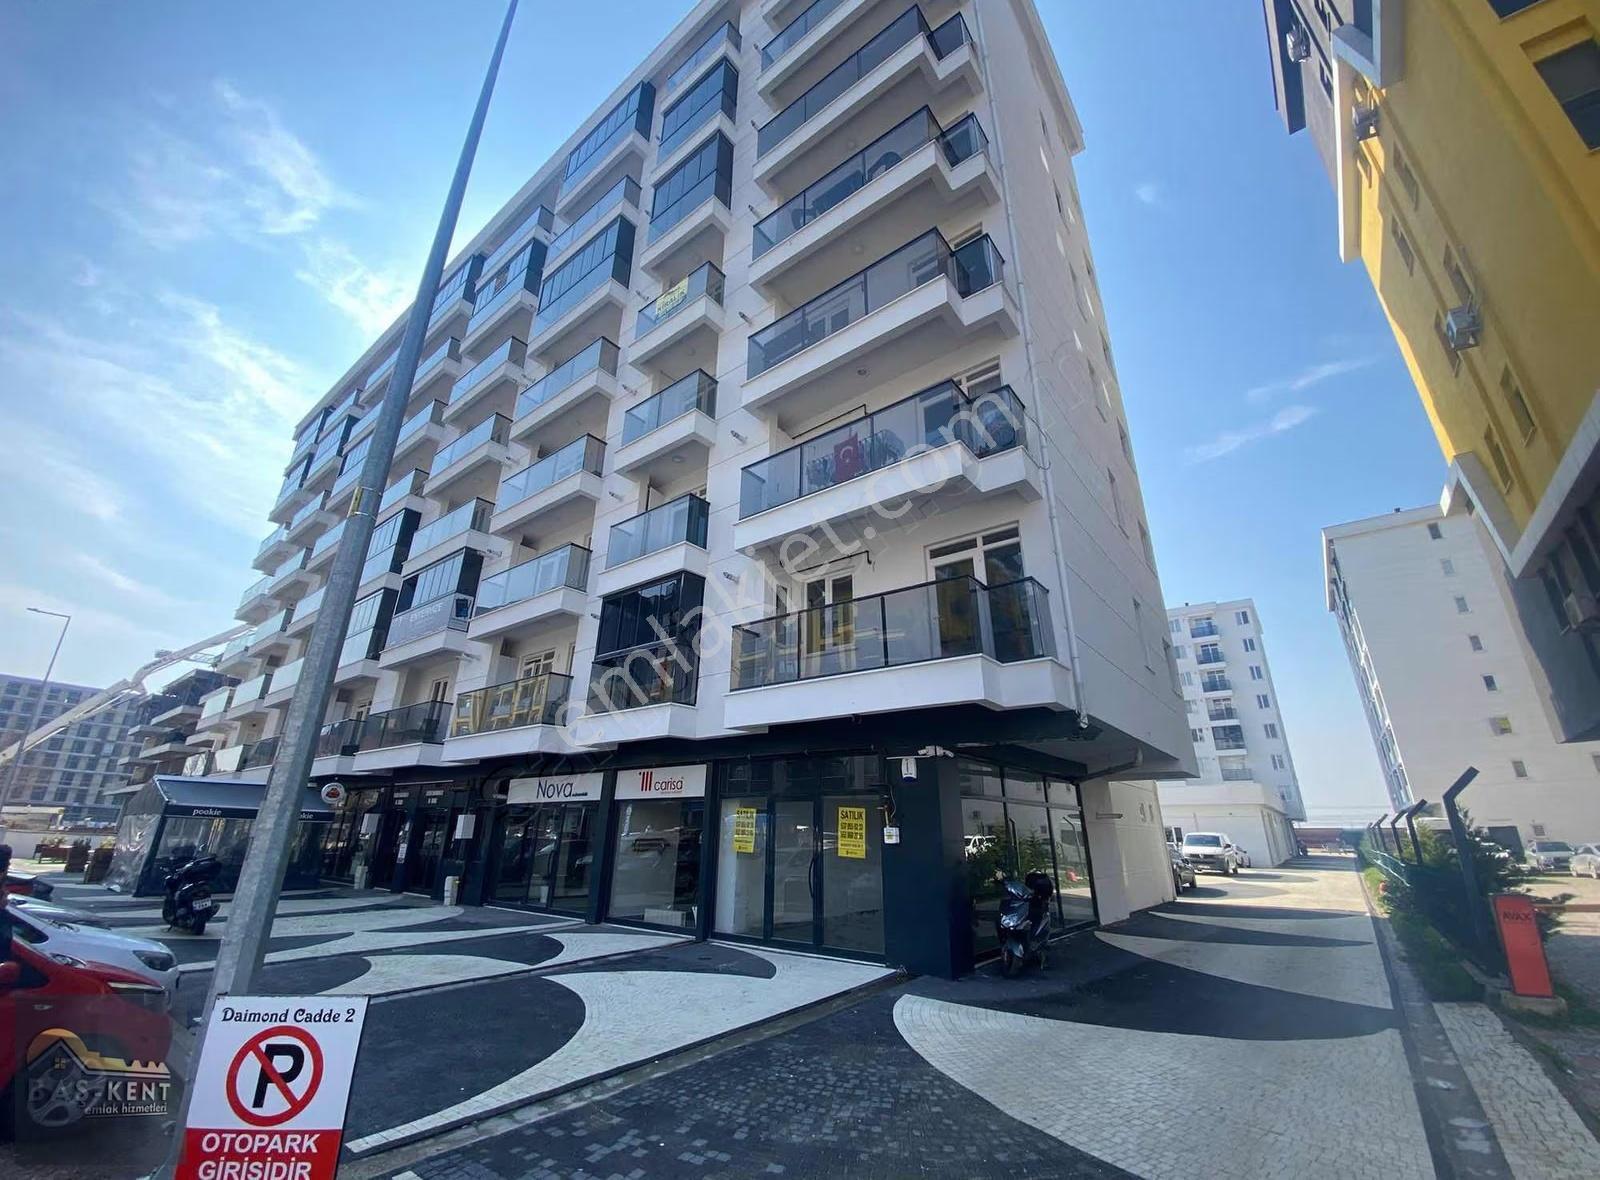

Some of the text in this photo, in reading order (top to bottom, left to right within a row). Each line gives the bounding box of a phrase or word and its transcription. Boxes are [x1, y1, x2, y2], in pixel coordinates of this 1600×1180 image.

[536, 779, 574, 799] Nova
[654, 778, 683, 792] carisa
[192, 808, 222, 816] pookie
[840, 809, 864, 820] SATILIK
[221, 1007, 356, 1023] Daimond Cadde 2
[201, 1132, 320, 1153] OTOPARK
